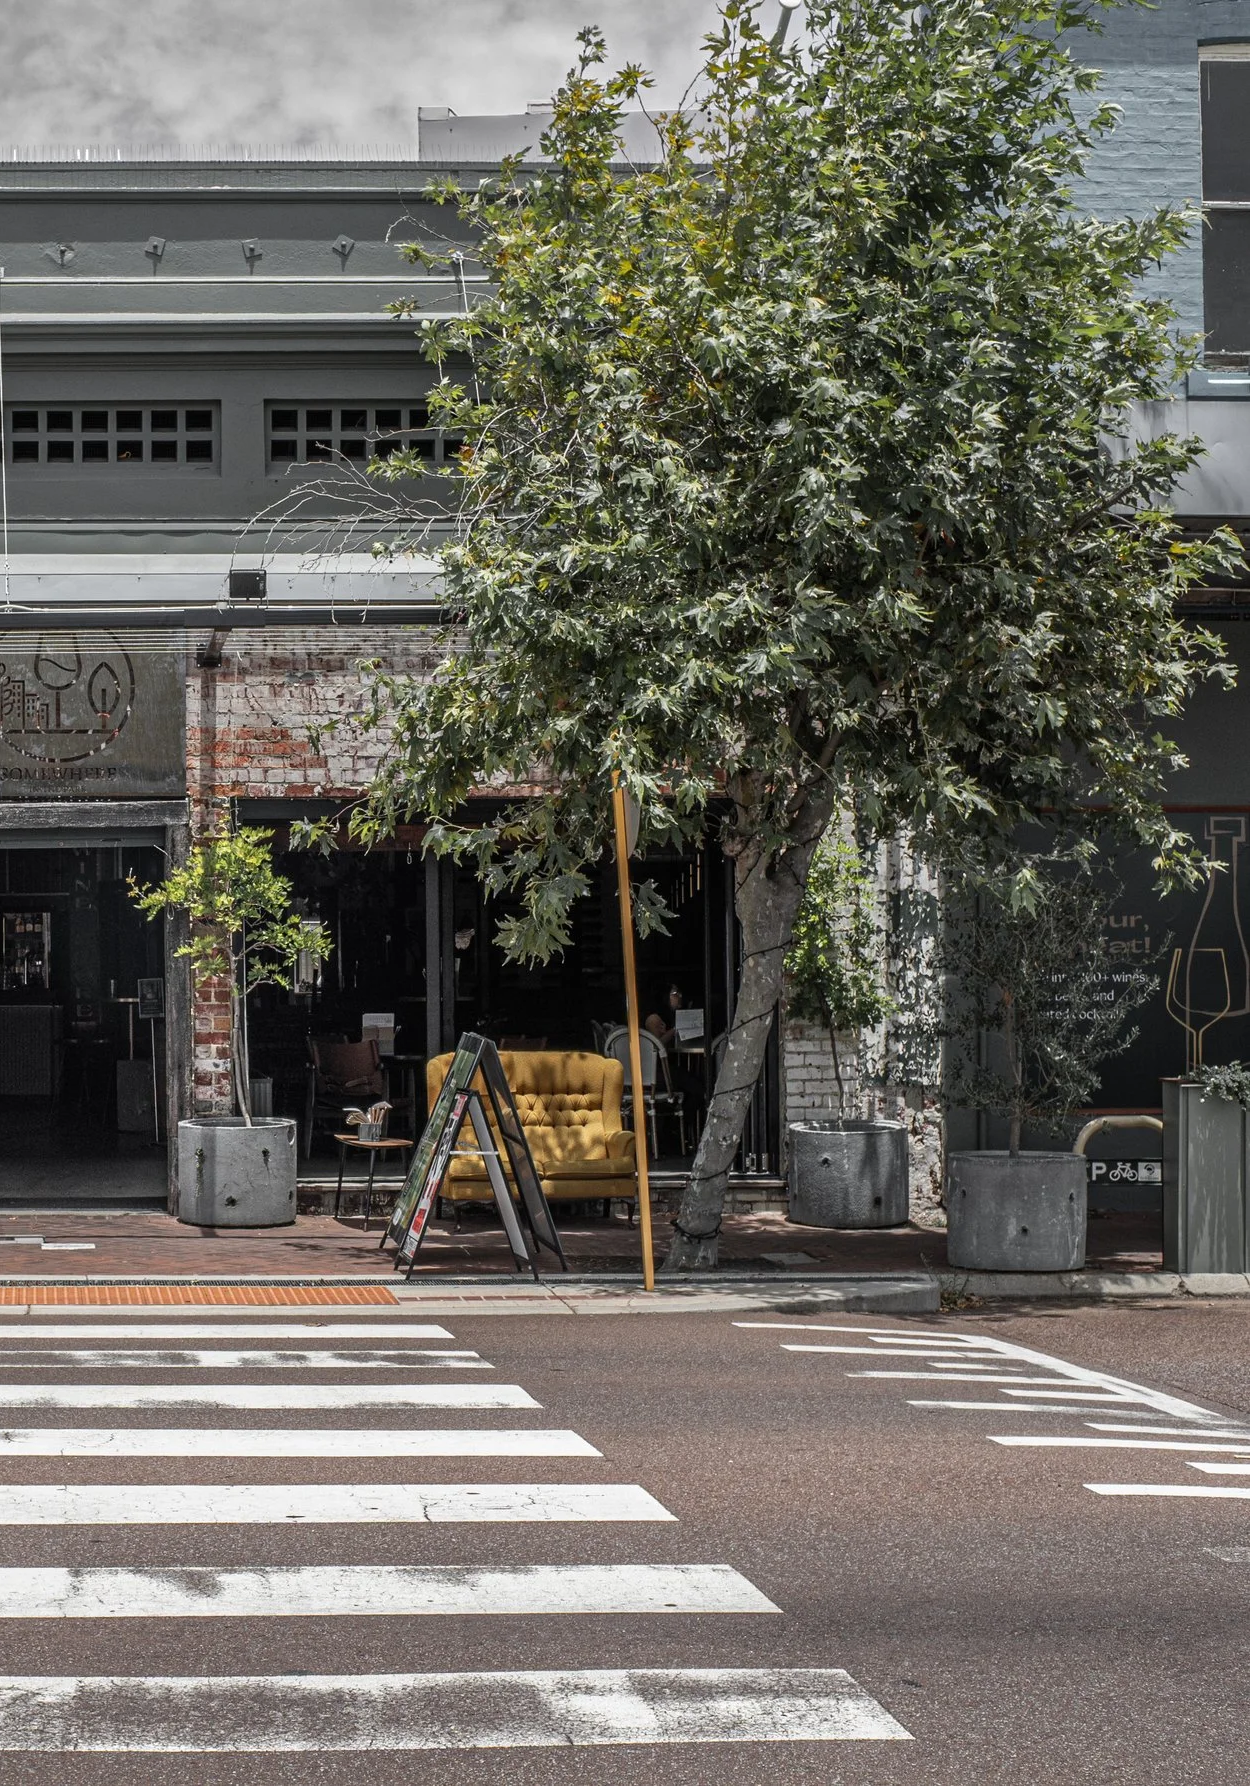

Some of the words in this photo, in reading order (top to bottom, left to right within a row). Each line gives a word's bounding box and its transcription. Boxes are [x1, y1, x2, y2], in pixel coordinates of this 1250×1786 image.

[0, 767, 117, 780] SOMEWHERE
[1092, 989, 1115, 1001] and
[1091, 1162, 1107, 1181] P
